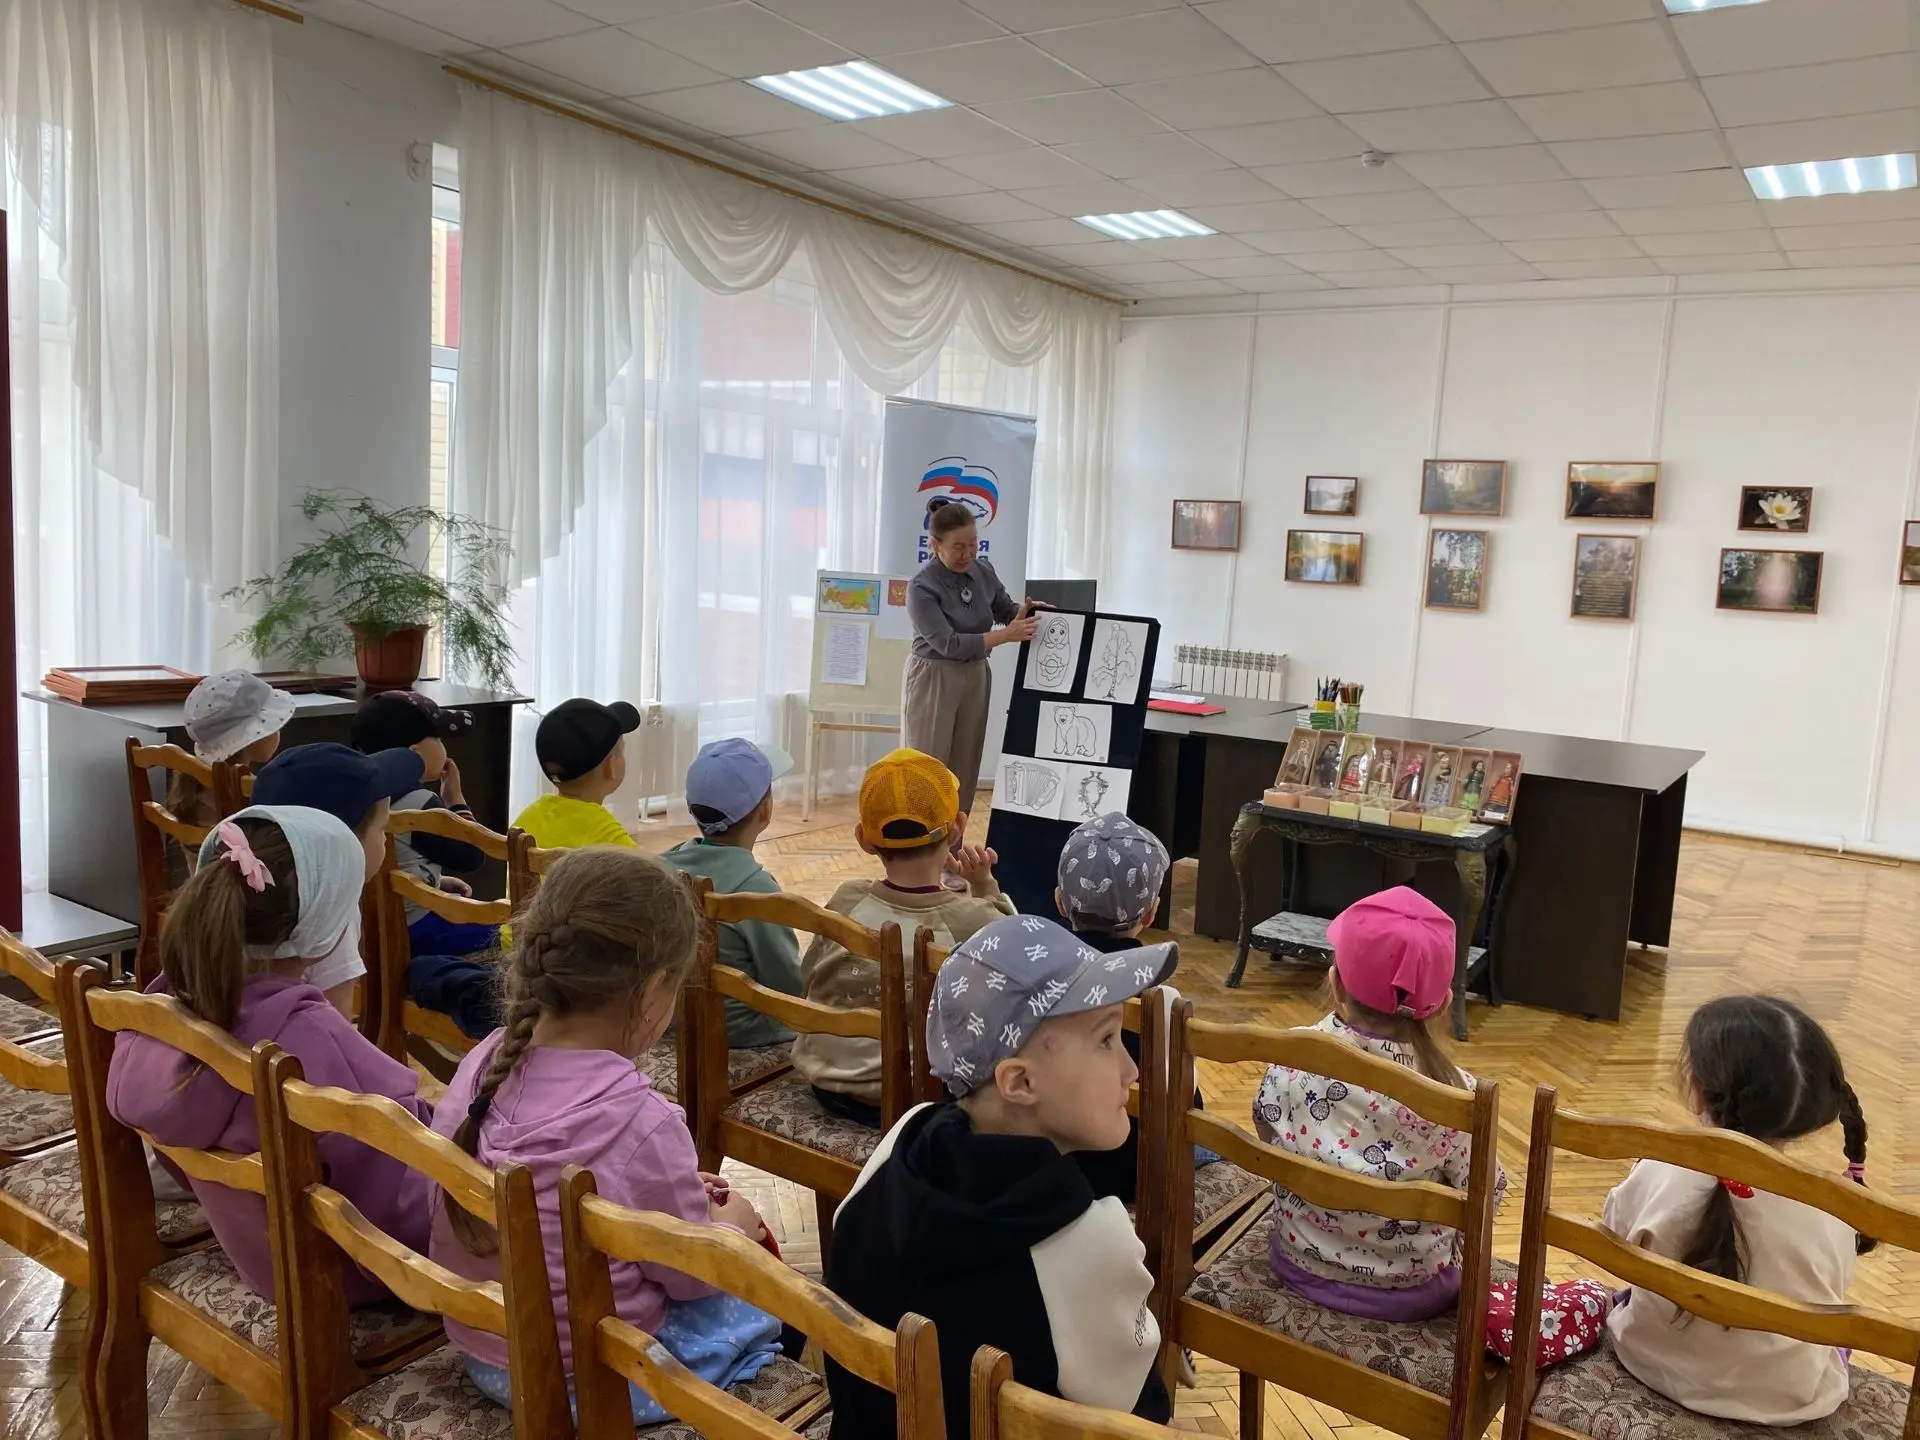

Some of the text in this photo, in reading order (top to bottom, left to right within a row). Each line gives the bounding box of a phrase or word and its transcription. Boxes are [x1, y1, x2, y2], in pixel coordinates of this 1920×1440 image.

[1084, 984, 1109, 1007] NY
[999, 1023, 1021, 1048] NY
[1391, 1128, 1414, 1152] LOVE
